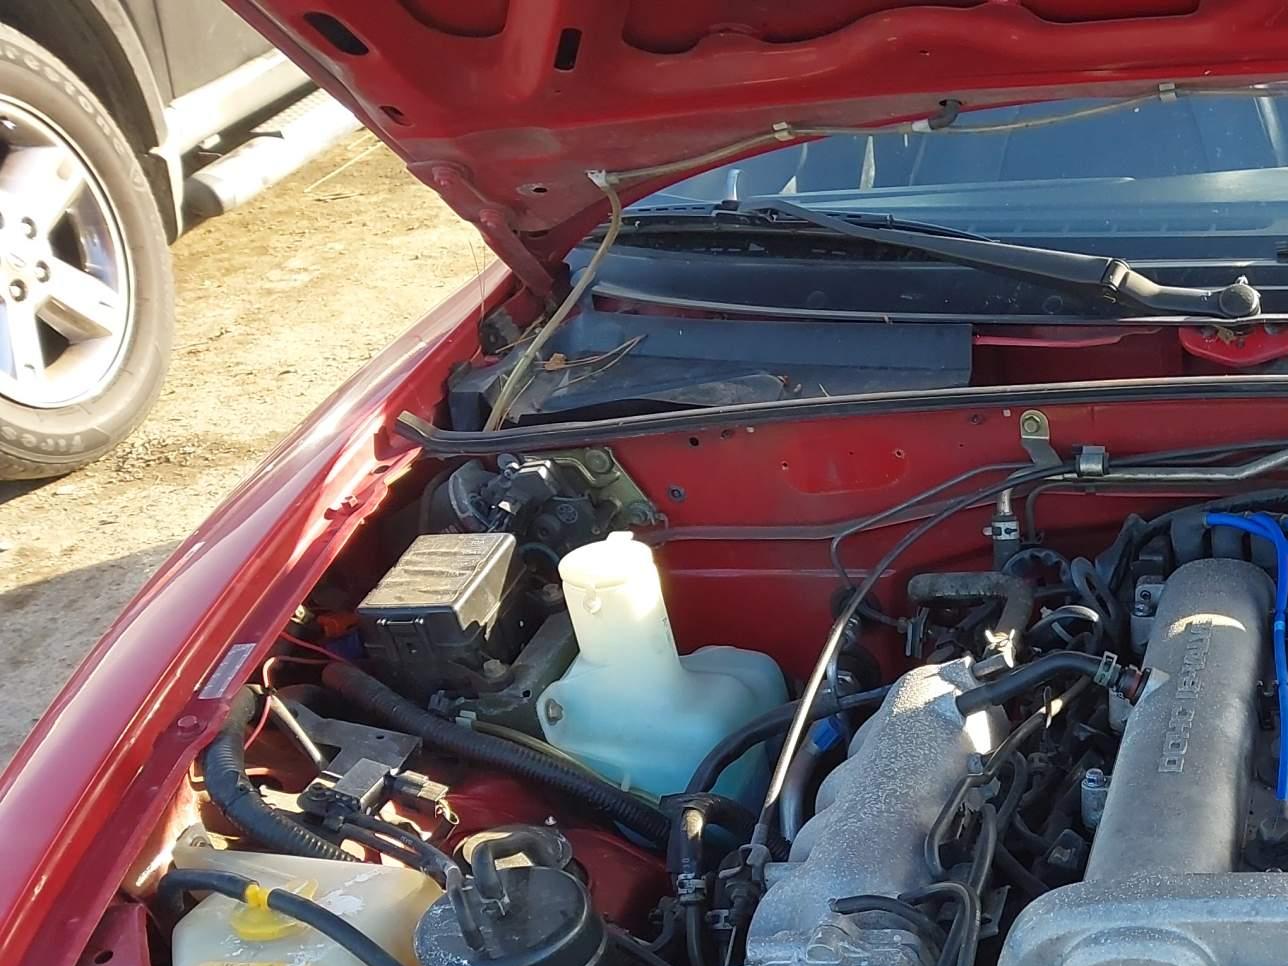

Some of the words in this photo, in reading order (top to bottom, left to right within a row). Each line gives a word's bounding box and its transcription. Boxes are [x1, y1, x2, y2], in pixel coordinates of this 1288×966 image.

[0, 45, 125, 155] restone
[0, 425, 85, 453] Fires
[1158, 705, 1195, 773] DOHC
